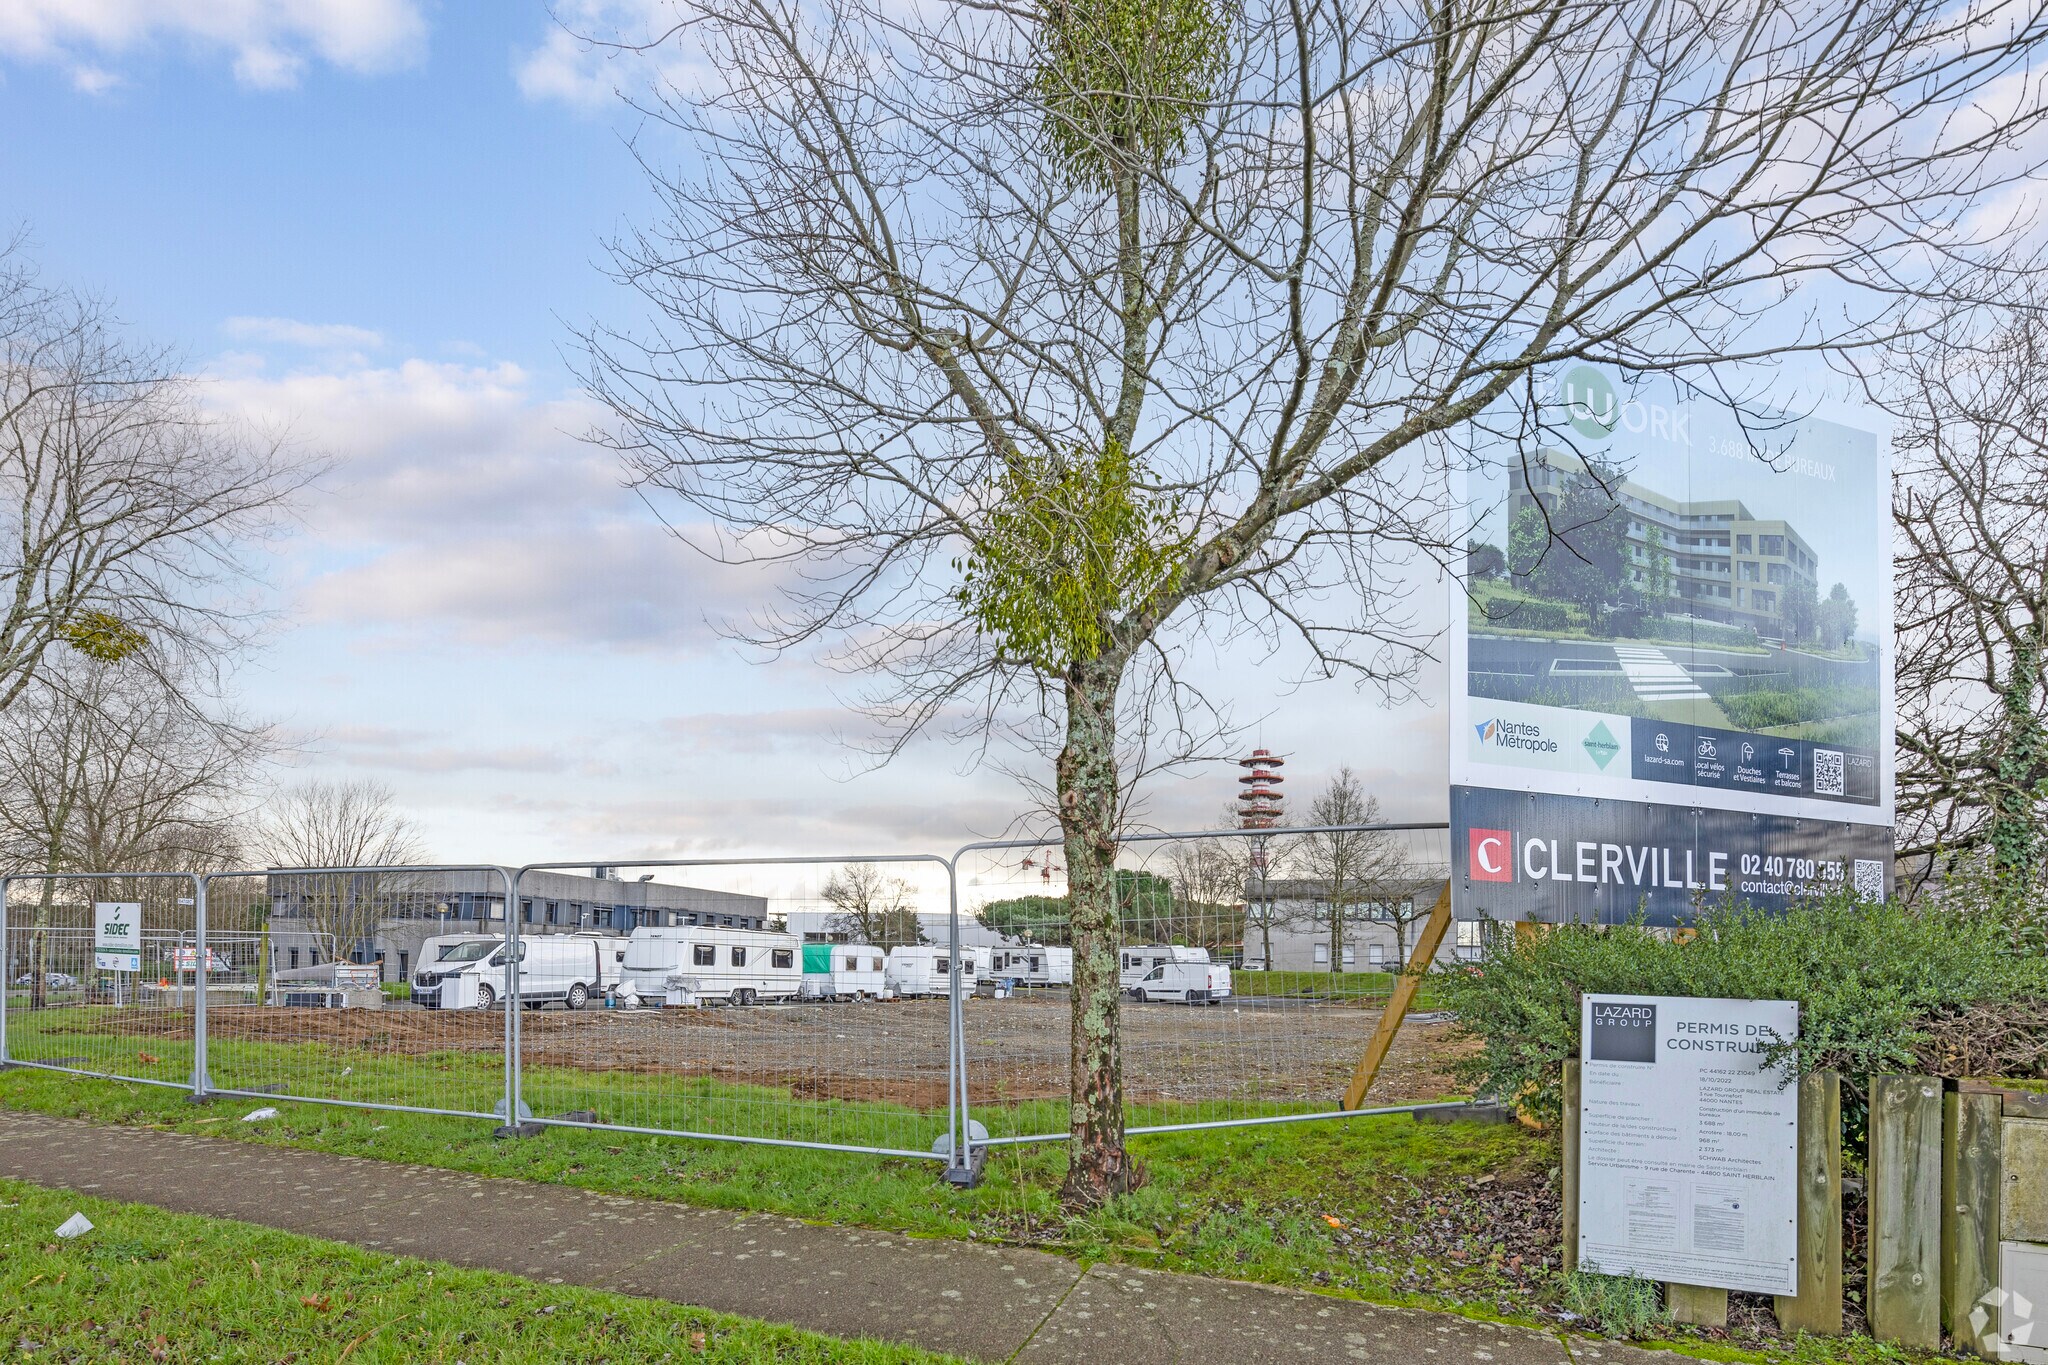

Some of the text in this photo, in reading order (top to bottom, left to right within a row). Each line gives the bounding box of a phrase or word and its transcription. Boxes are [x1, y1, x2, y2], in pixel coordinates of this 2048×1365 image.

[1708, 436, 1744, 460] 3.688
[1784, 454, 1836, 482] BUREAUX
[1496, 718, 1540, 737] Nantes
[1644, 754, 1685, 767] lazard-sa.com
[1847, 757, 1872, 768] LAZARD
[1710, 762, 1725, 771] vélos
[1737, 766, 1762, 776] Douches
[1697, 770, 1721, 779] sécurisé
[1740, 774, 1766, 785] Vestiaires
[1775, 770, 1800, 781] Terrasses
[1781, 779, 1802, 788] balcons
[1523, 837, 1728, 891] CLERVILLE
[1740, 853, 1761, 876] 02
[1764, 855, 1783, 877] 40
[1786, 857, 1815, 880] 780
[104, 923, 130, 935] SIDEC
[1595, 1006, 1652, 1019] LAZARD
[1595, 1018, 1652, 1027] GROUP
[1676, 1021, 1769, 1036] PERMIS DE
[1667, 1038, 1778, 1054] CONSTRUI
[1699, 1076, 1732, 1084] 18/10/2022
[1588, 1112, 1616, 1120] Superficie
[1621, 1131, 1650, 1139] bâtiments
[1588, 1146, 1617, 1154] Architecte
[1609, 1162, 1640, 1170] Urbanisme
[1727, 1157, 1762, 1165] Architectes
[1706, 1164, 1748, 1173] Saint-Herblain
